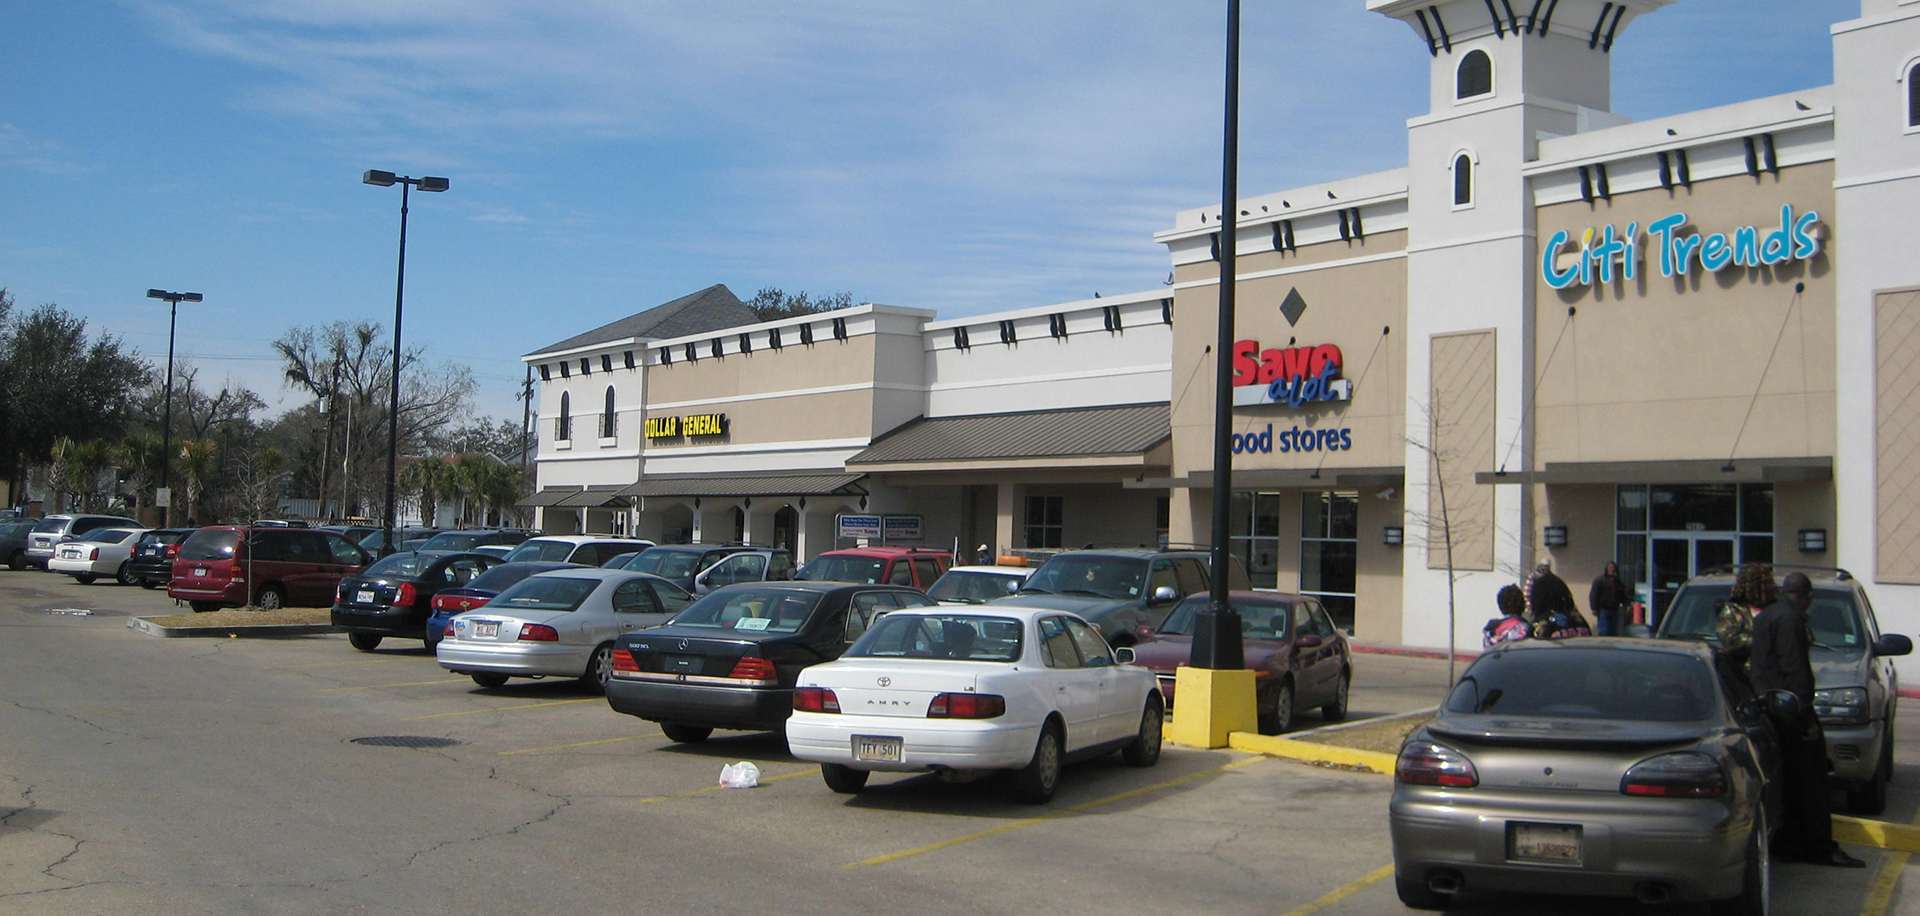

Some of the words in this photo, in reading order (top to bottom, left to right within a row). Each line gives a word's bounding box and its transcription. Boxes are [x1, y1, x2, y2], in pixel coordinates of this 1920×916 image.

[1542, 221, 1639, 289] Citi
[1647, 203, 1820, 278] Trends
[1233, 340, 1342, 387] Save
[645, 417, 678, 438] DOLLAR
[682, 414, 722, 436] GENERAL
[1231, 424, 1272, 454] ood
[1280, 425, 1351, 452] stores
[862, 743, 877, 754] TFY
[882, 744, 897, 756] 501
